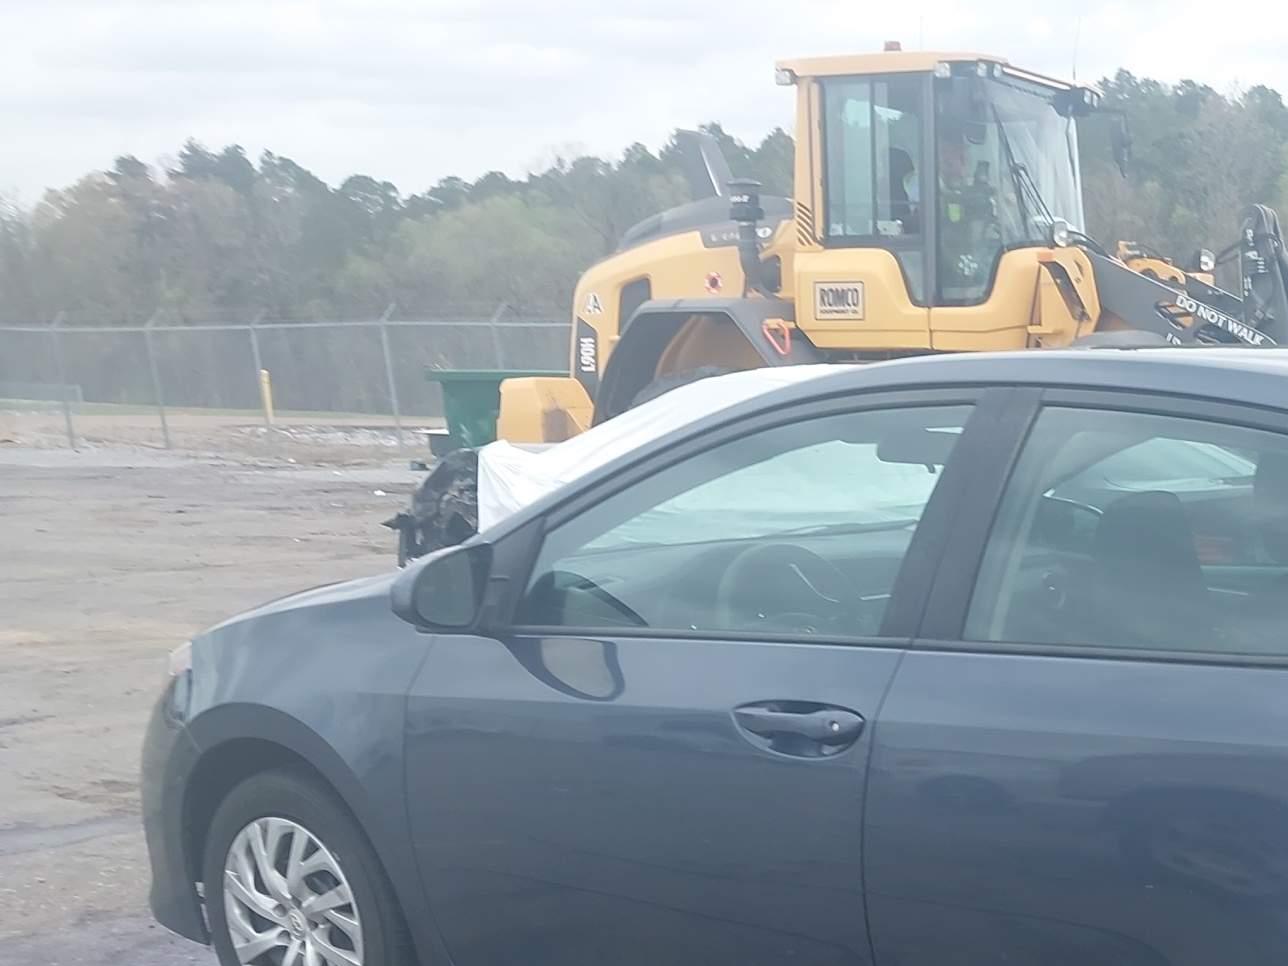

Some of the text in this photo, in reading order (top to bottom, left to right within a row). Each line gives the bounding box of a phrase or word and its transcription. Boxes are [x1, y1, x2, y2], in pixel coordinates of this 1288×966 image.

[820, 287, 859, 307] ROMCO
[1176, 295, 1265, 345] DO NOT WALK
